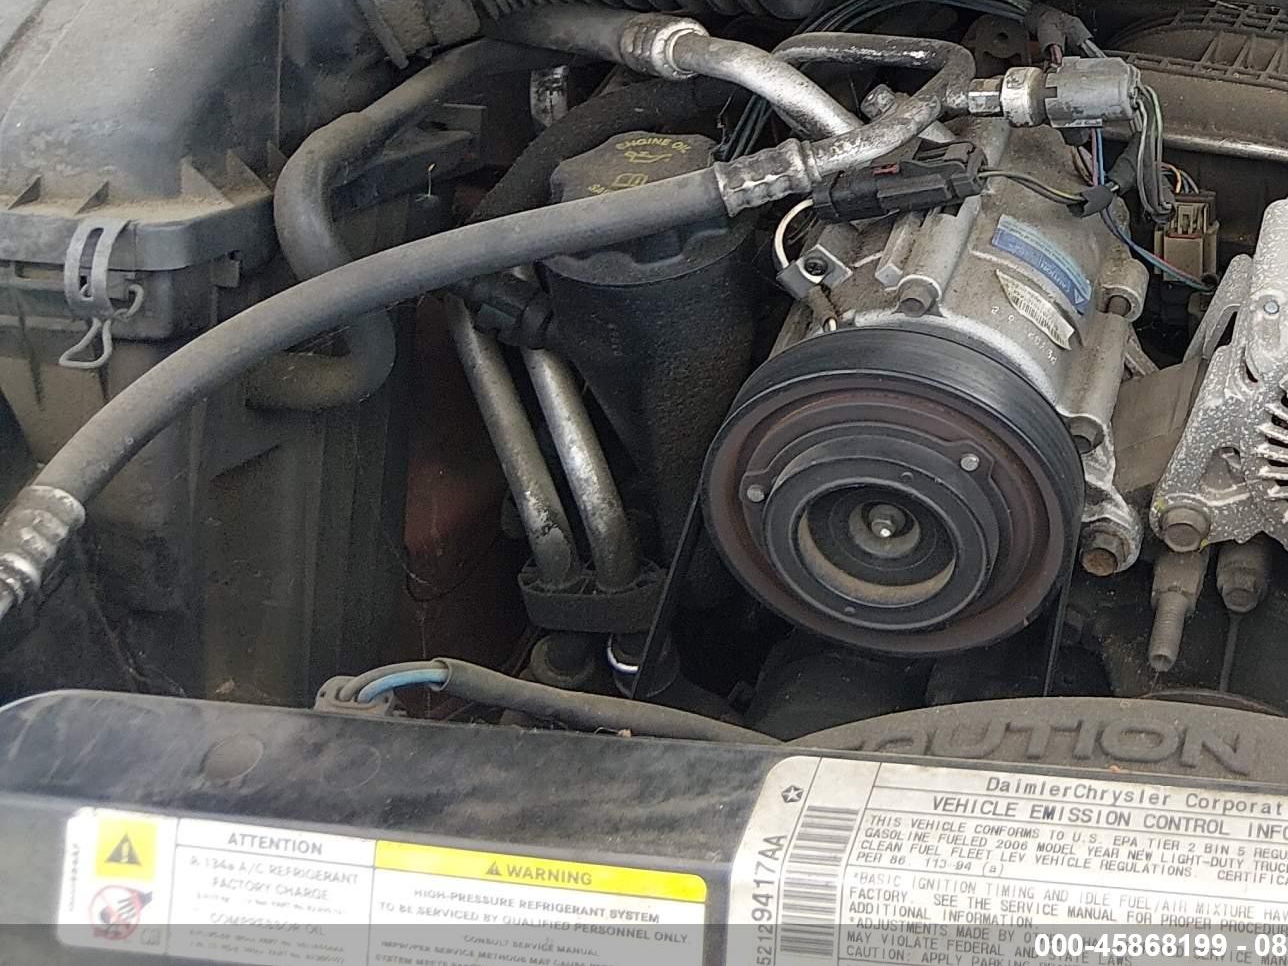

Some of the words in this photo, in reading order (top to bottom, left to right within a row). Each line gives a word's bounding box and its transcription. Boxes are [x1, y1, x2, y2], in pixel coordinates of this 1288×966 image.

[985, 776, 1171, 806] DaimlerChrysler
[933, 795, 1017, 817] VEHICLE
[1029, 803, 1130, 827] EMISSION
[1143, 813, 1230, 836] CONTROL
[227, 831, 322, 855] ATTENTION
[864, 826, 929, 843] GASOLINE
[937, 833, 987, 848] FUELED
[995, 838, 1027, 851] 2006
[1036, 841, 1076, 856] MODEL
[1087, 845, 1118, 858] YEAR
[1127, 849, 1152, 861] NEW
[1160, 851, 1244, 869] LIGHT-DUTY
[870, 814, 901, 828] THIS
[910, 817, 965, 833] VEHICLE
[974, 823, 1039, 840] CONFORMS
[1049, 829, 1064, 842] TO
[1113, 834, 1137, 847] EPA
[1147, 837, 1179, 851] TIER
[1187, 841, 1195, 852] 2
[1204, 842, 1229, 855] BIN
[1237, 845, 1245, 857] 5
[856, 851, 882, 863] PER
[860, 839, 902, 853] CLEAN
[909, 843, 941, 856] FUEL
[950, 847, 991, 861] FLEET
[1000, 851, 1025, 864] LEV
[1035, 854, 1090, 868] VEHICLE
[506, 864, 593, 886] WARNING
[413, 887, 514, 908] HIGH-PRESSURE
[518, 898, 605, 918] REFRIGERANT
[608, 907, 660, 924] SYSTEM
[849, 900, 930, 920] ADDITIONAL
[913, 876, 975, 894] IGNITION
[990, 882, 1034, 899] TIMING
[1044, 887, 1068, 902] AND
[1079, 890, 1113, 906] IDLE
[1119, 894, 1187, 913] FUEL/AIR
[1195, 900, 1254, 919] MIXTURE
[933, 893, 957, 908] SEE
[968, 896, 991, 911] THE
[1000, 899, 1059, 917] SERVICE
[1067, 905, 1117, 922] MANUAL
[1126, 910, 1151, 925] FOR
[1160, 913, 1211, 930] PROPER
[380, 900, 394, 912] TO
[415, 904, 478, 921] SERVICED
[483, 911, 497, 923] BY
[502, 913, 570, 931] QUALIFIED
[574, 922, 649, 940] PERSONNEL
[653, 930, 688, 944] ONLY
[956, 924, 990, 940] MADE
[998, 928, 1014, 943] BY
[847, 930, 871, 945] MAY
[881, 933, 938, 950] VIOLATE
[946, 938, 1005, 956] FEDERAL
